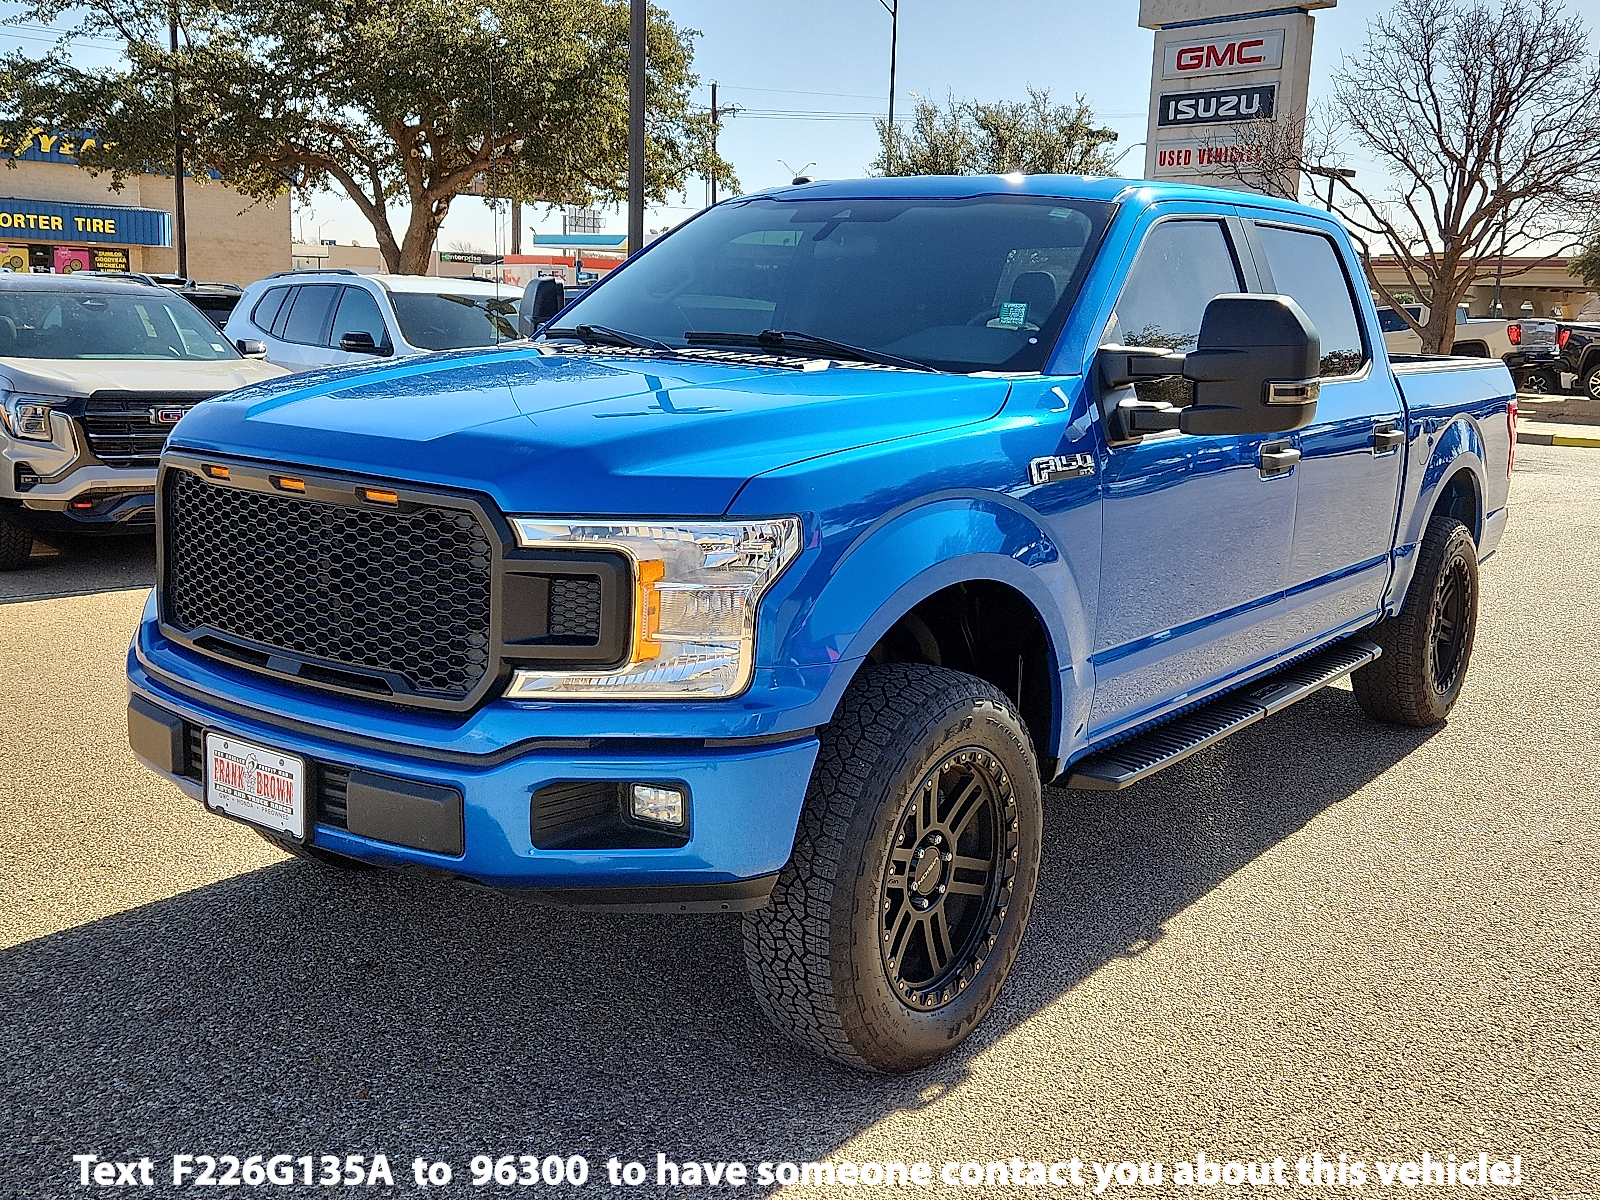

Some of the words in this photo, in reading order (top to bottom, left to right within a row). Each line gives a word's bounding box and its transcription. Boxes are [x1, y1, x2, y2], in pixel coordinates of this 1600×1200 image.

[1176, 39, 1263, 71] GMC
[1168, 93, 1260, 121] ISUZU
[1159, 149, 1192, 167] USED
[74, 217, 116, 234] TIRE
[443, 254, 482, 263] enterprise
[214, 757, 245, 791] FRANK
[256, 770, 294, 804] BROWN
[215, 784, 232, 794] AUTO
[233, 789, 246, 799] AND
[247, 794, 269, 807] TRUCK
[270, 801, 292, 815] RANCH
[218, 793, 230, 801] GMC
[236, 797, 254, 809] HONDA
[261, 806, 290, 821] PREOWNED
